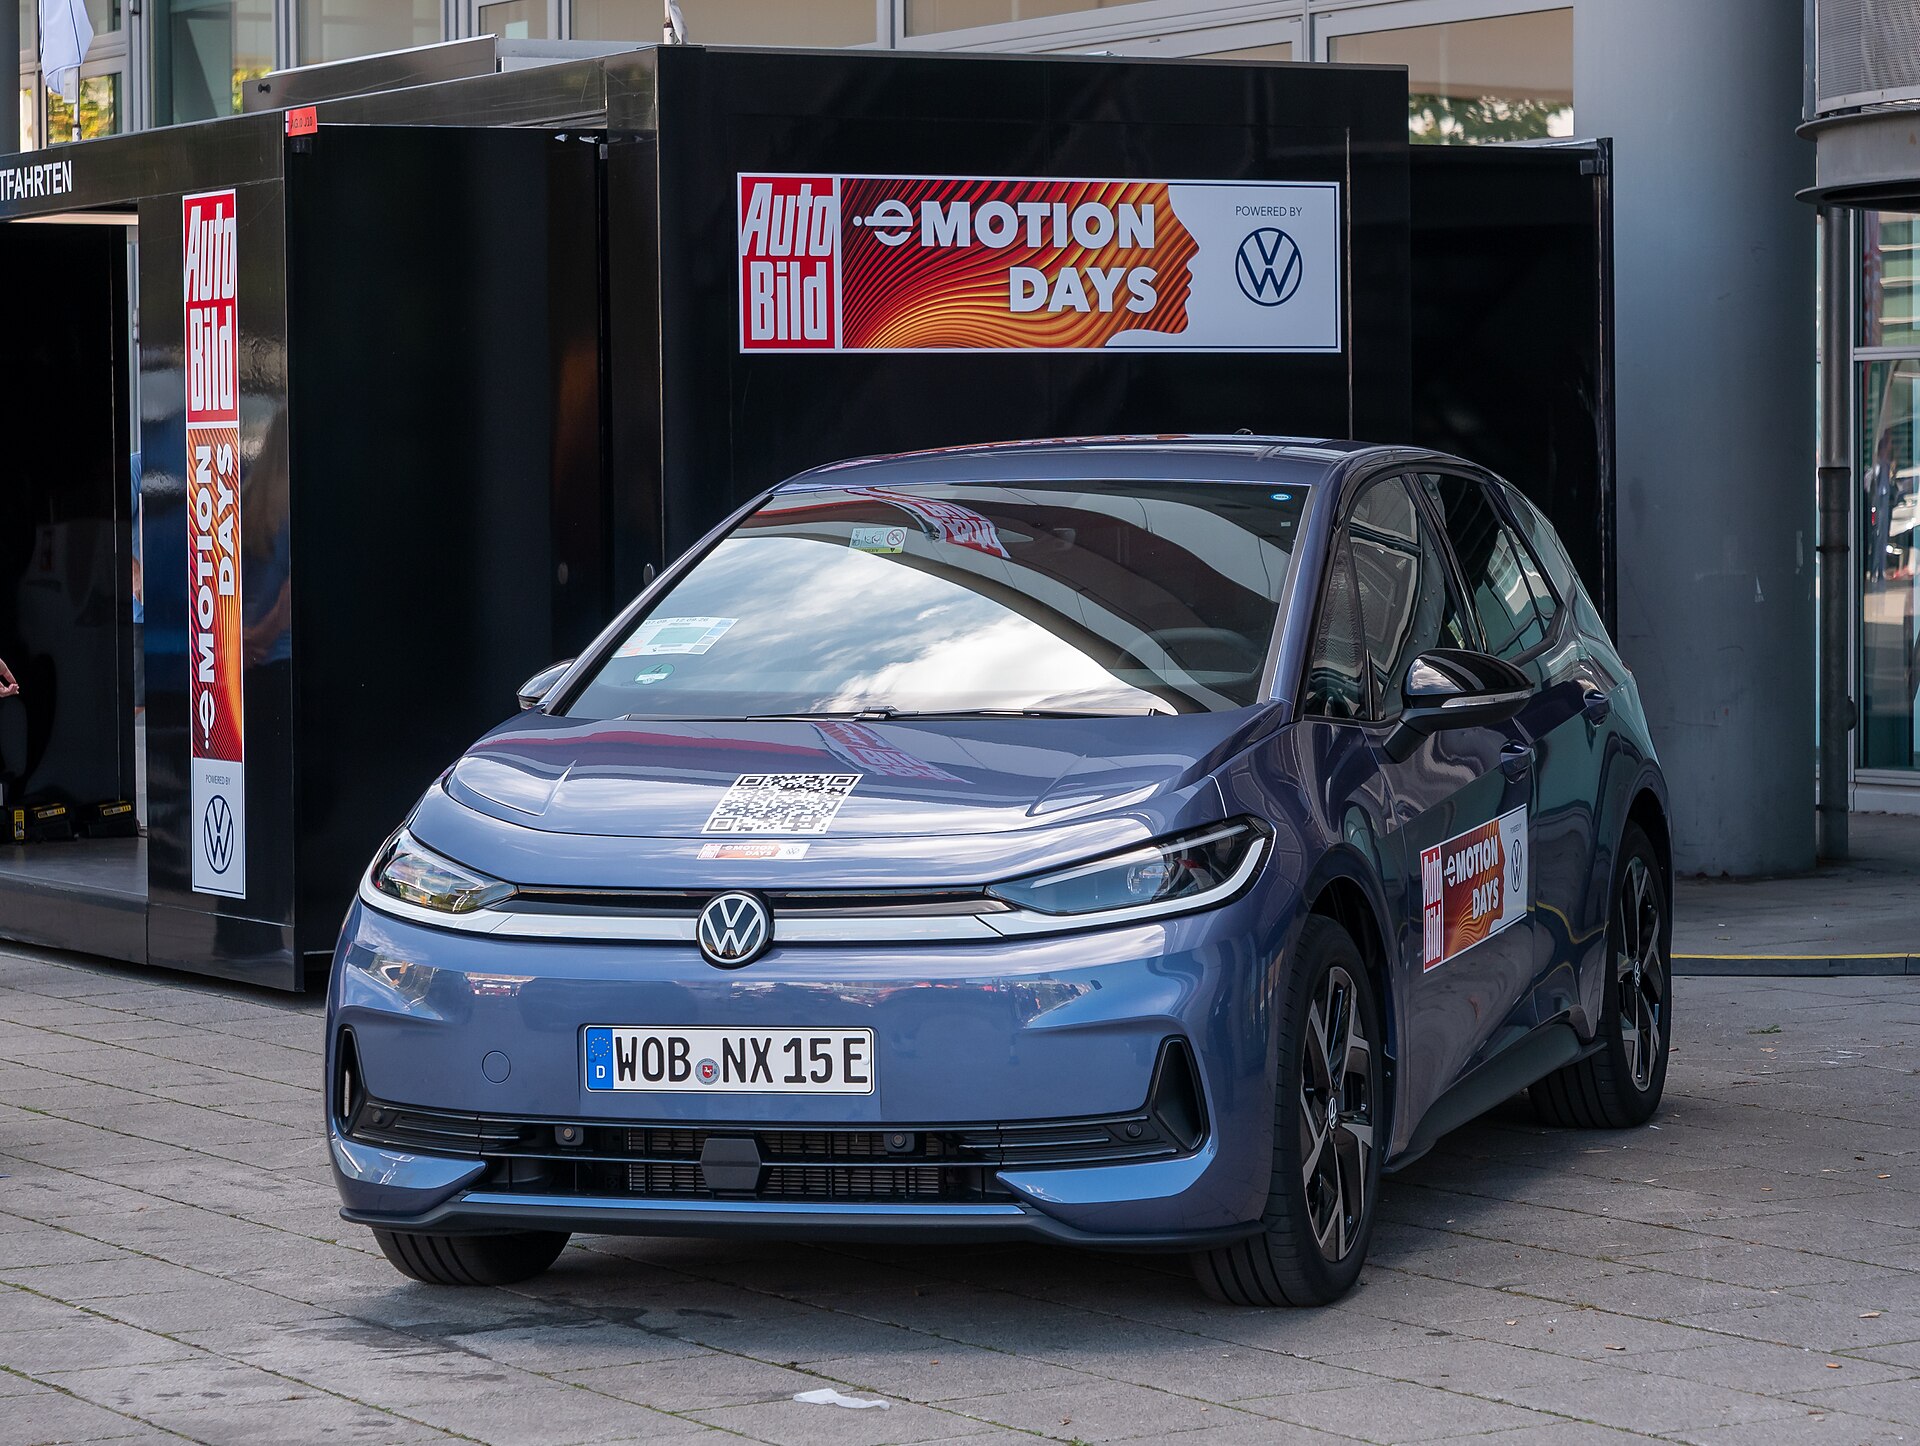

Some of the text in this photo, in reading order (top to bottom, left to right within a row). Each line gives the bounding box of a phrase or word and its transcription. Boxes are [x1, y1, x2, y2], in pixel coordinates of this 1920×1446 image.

[0, 160, 72, 201] TFAHRTEN
[741, 183, 833, 256] Auto
[1235, 206, 1303, 217] POWERED BY
[184, 203, 235, 302] Auto
[750, 261, 828, 341] Bild
[1009, 266, 1158, 313] DAYS
[190, 306, 234, 411] Bild
[216, 443, 235, 596] DAYS
[1422, 852, 1441, 907] Auto
[1472, 877, 1499, 919] DAYS
[1425, 904, 1441, 963] Bild
[596, 1065, 605, 1078] D
[615, 1036, 692, 1082] WOB
[722, 1037, 772, 1083] NX
[783, 1037, 834, 1084] 15
[843, 1037, 868, 1083] E
